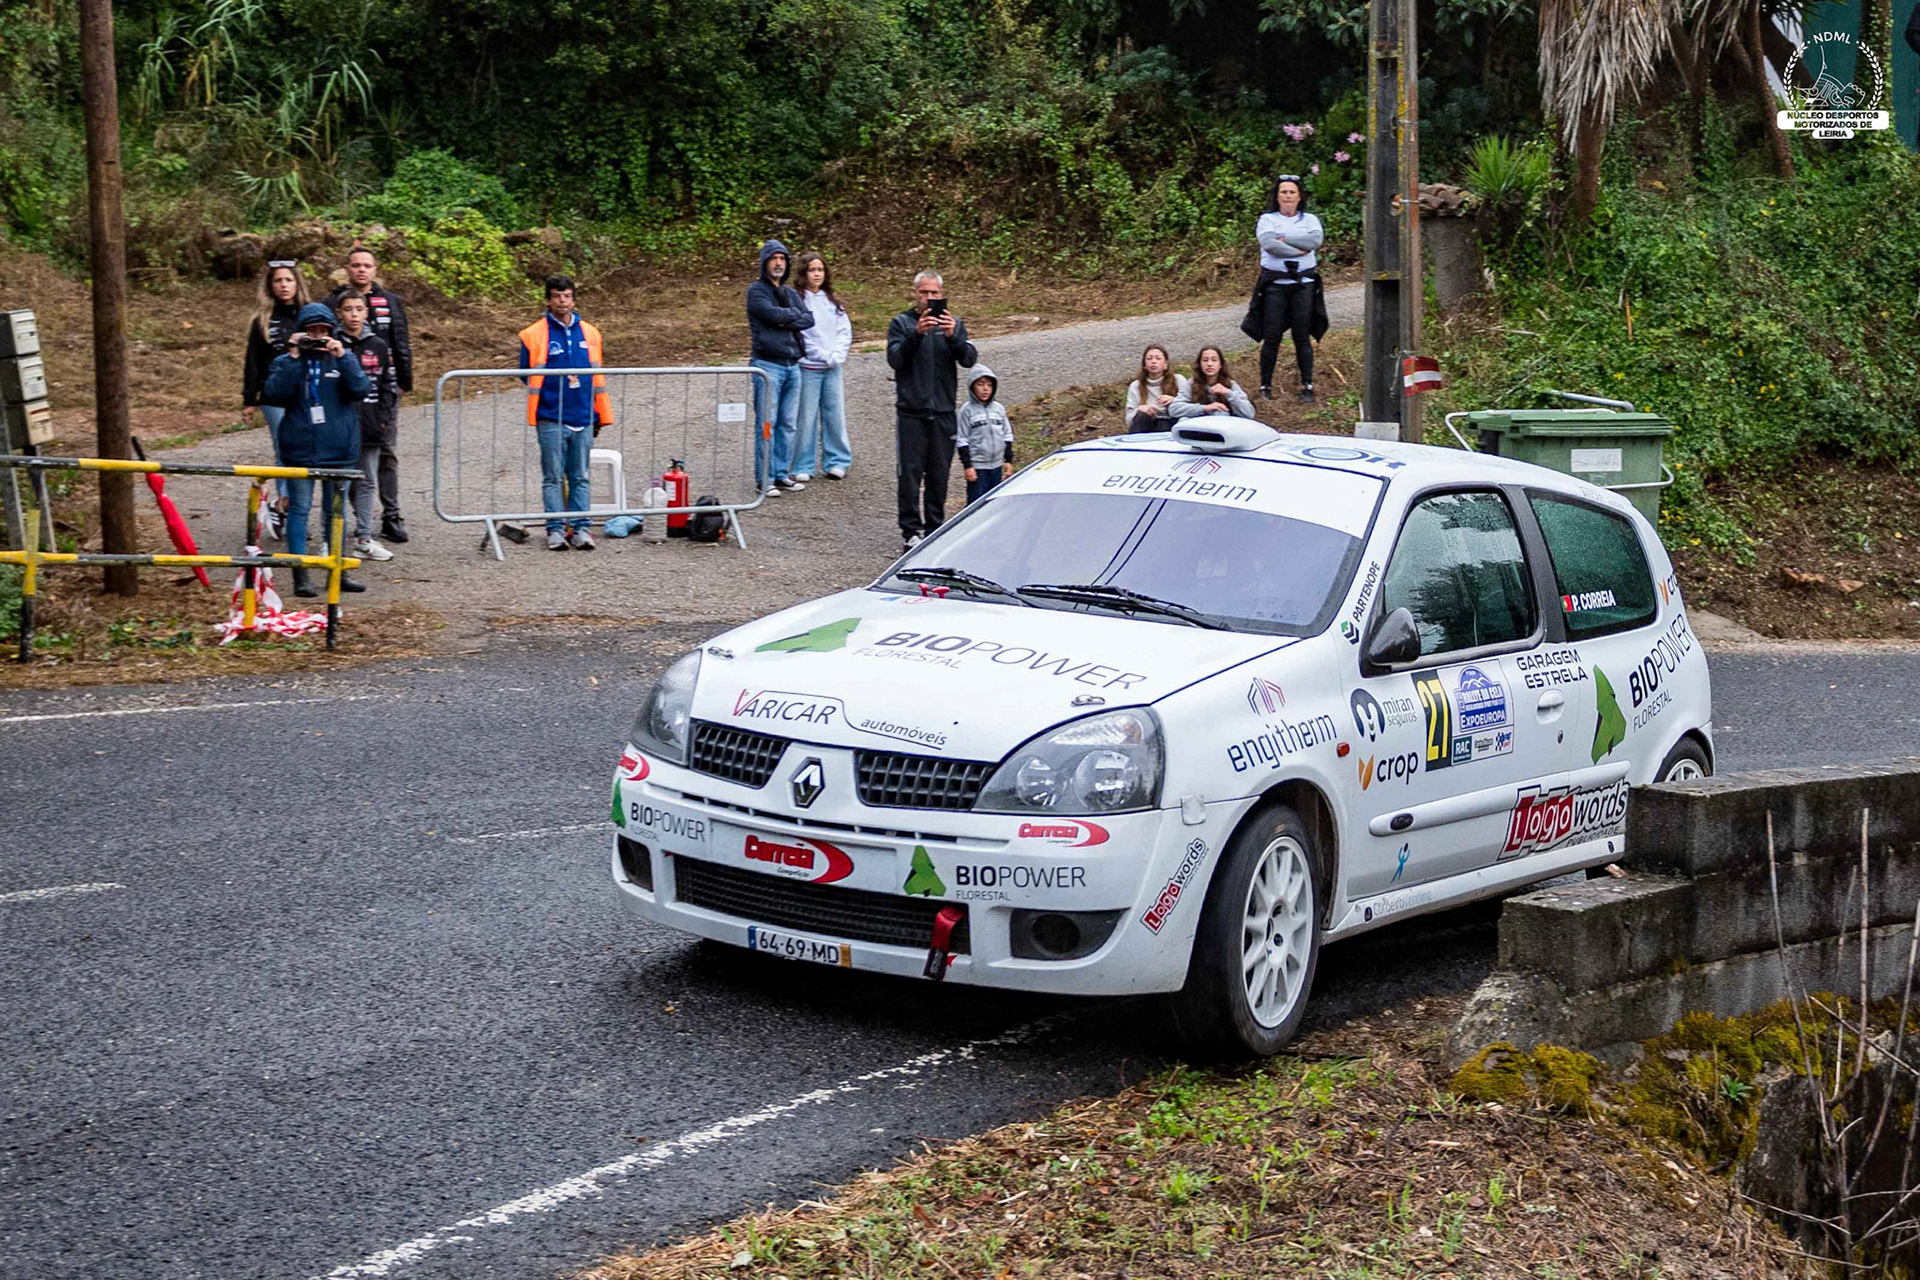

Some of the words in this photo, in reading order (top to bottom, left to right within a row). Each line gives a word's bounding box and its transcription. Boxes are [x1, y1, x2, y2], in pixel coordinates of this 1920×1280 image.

[1102, 472, 1257, 502] engitherm
[1352, 561, 1381, 622] PARTENOPE
[1571, 594, 1581, 612] P.
[1580, 589, 1617, 611] CORREIA
[852, 649, 965, 669] FLORESTAL
[874, 632, 1148, 690] BIOPOWER
[1516, 649, 1581, 671] GARAGEM
[1629, 614, 1694, 708] BIOPOWER
[1525, 666, 1589, 689] ESTRELA
[733, 688, 837, 725] VARICAR
[860, 717, 948, 745] automóveis
[1383, 697, 1415, 715] miran
[1387, 711, 1418, 727] seguros
[1460, 709, 1506, 729] EXPOEUROPA
[1633, 688, 1673, 732] FLORESTAL
[1417, 679, 1448, 761] 27
[1227, 715, 1337, 772] engitherm
[1455, 740, 1470, 755] RAC
[1377, 752, 1419, 785] crop
[631, 801, 706, 843] BIOPOWER
[955, 865, 1087, 888] BIOPOWER
[955, 890, 1011, 902] FLORESTAL
